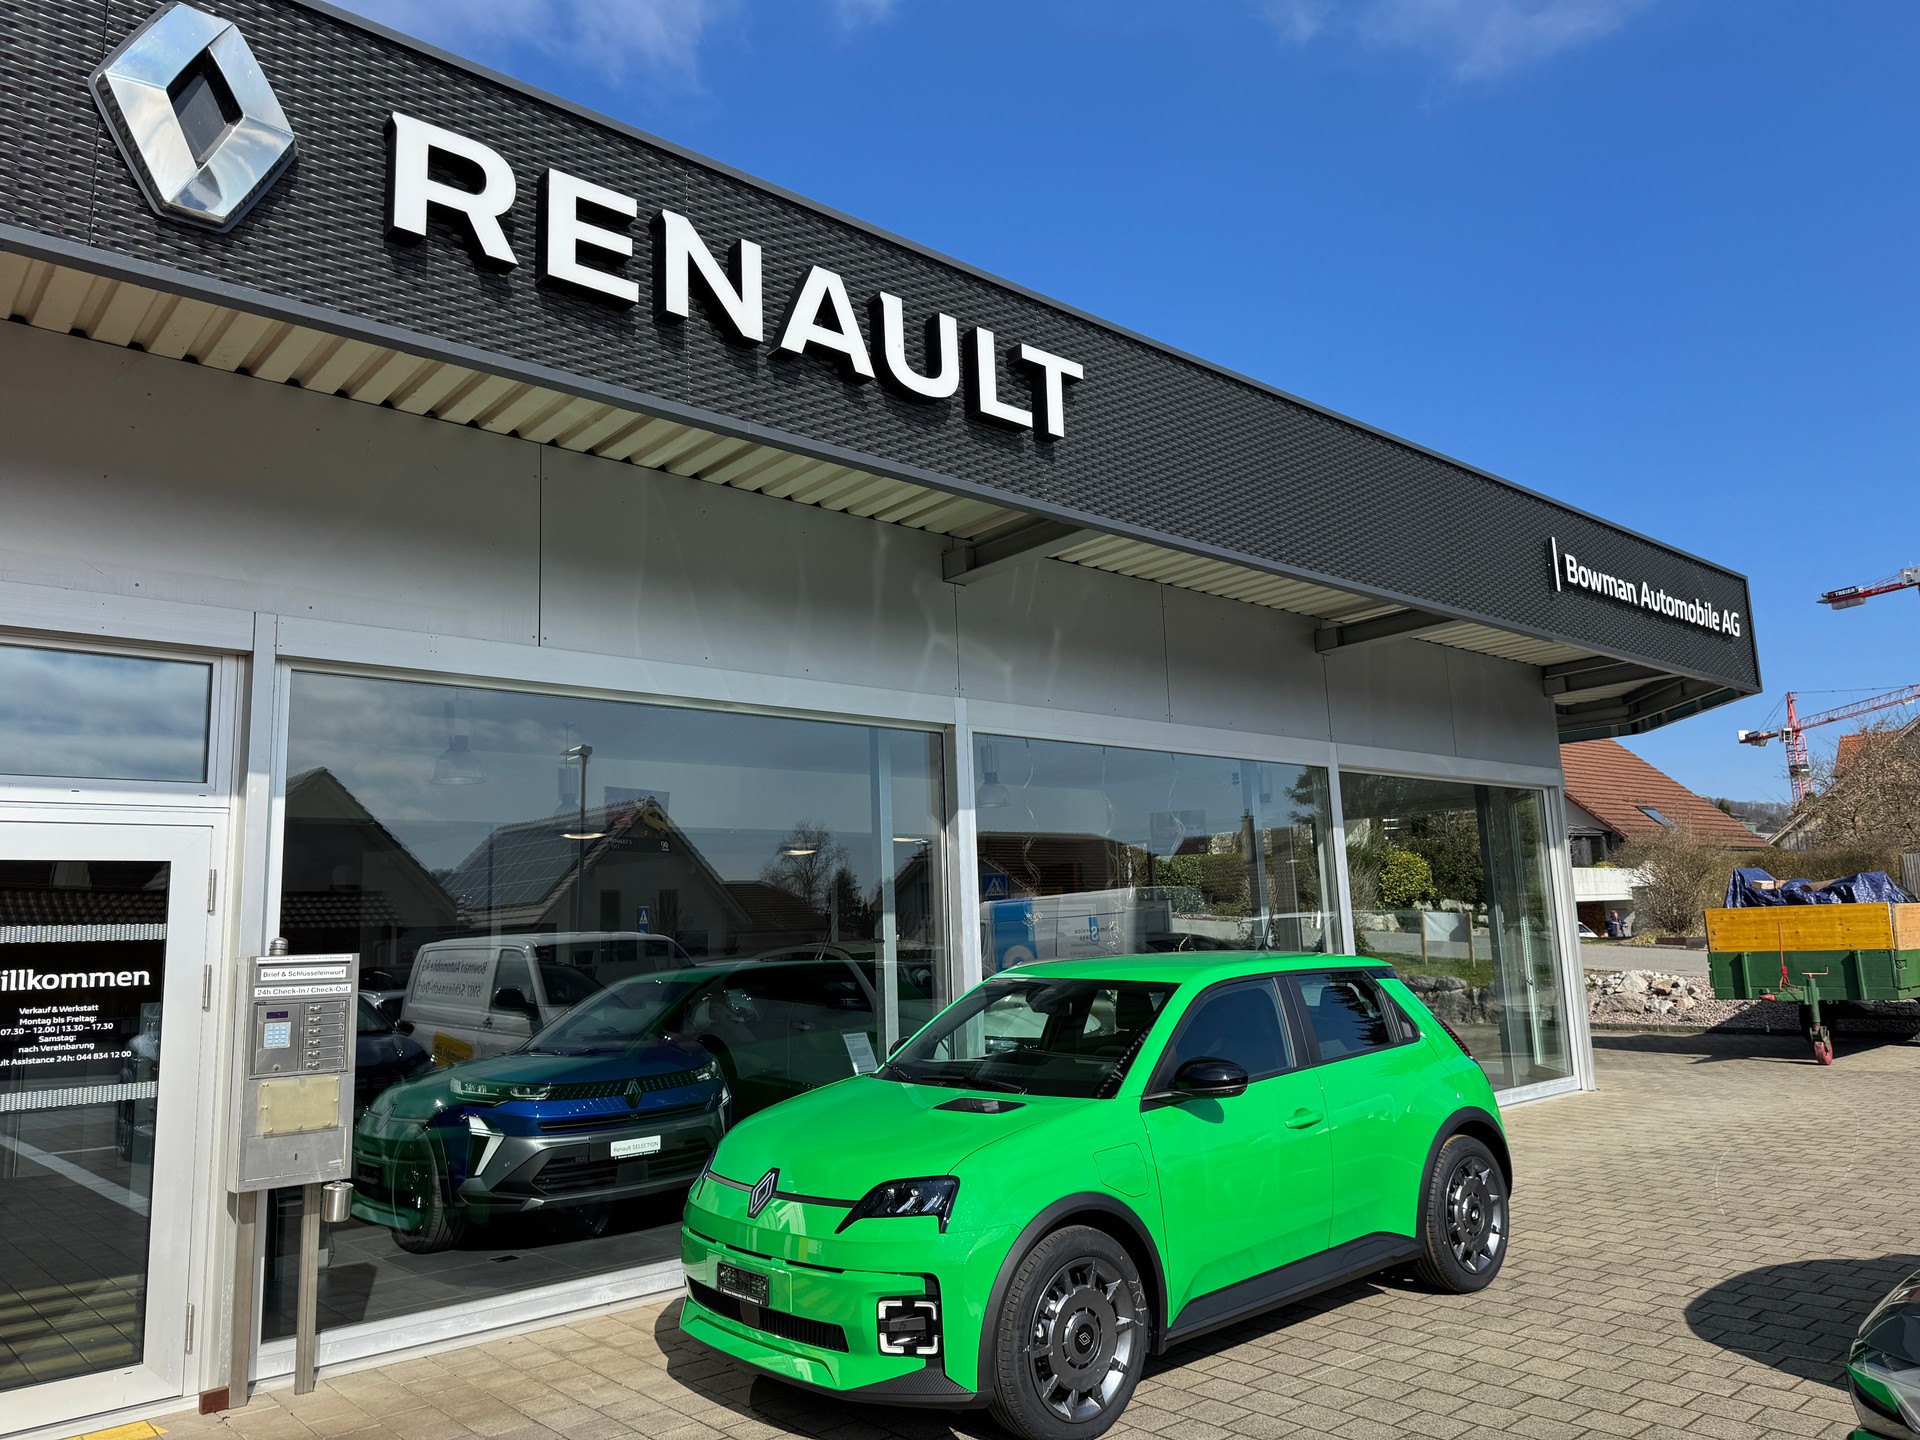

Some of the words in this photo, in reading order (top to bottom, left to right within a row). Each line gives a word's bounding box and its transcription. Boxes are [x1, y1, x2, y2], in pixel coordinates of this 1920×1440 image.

[387, 111, 1084, 440] RENAULT
[1564, 553, 1638, 604] Bowman
[1640, 581, 1720, 631] Automobile
[1721, 609, 1741, 637] AG
[262, 970, 281, 978] Brief
[281, 970, 287, 978] &
[0, 969, 151, 992] illkommen
[257, 988, 272, 996] 24h
[273, 987, 306, 996] Check-In
[310, 985, 349, 994] Check-Out
[19, 1006, 51, 1015] Verkauf
[59, 1004, 99, 1013] Werkstatt
[19, 1018, 51, 1026] Montag
[53, 1016, 65, 1024] bis
[66, 1015, 97, 1024] Freitag:
[0, 1027, 25, 1036] 07.30
[33, 1026, 56, 1035] 12.00
[62, 1024, 84, 1032] 13.30
[91, 1022, 114, 1031] 17.30
[38, 1034, 77, 1043] Samstag:
[18, 1045, 39, 1053] nach
[40, 1042, 95, 1053] Vereinbarung
[10, 1055, 55, 1066] Assistance
[56, 1054, 75, 1063] 24h:
[76, 1053, 92, 1061] 044
[93, 1052, 109, 1060] 834
[110, 1051, 121, 1059] 12
[121, 1050, 132, 1058] 00
[613, 1144, 632, 1153] Renault
[632, 1141, 659, 1150] SELECTION
